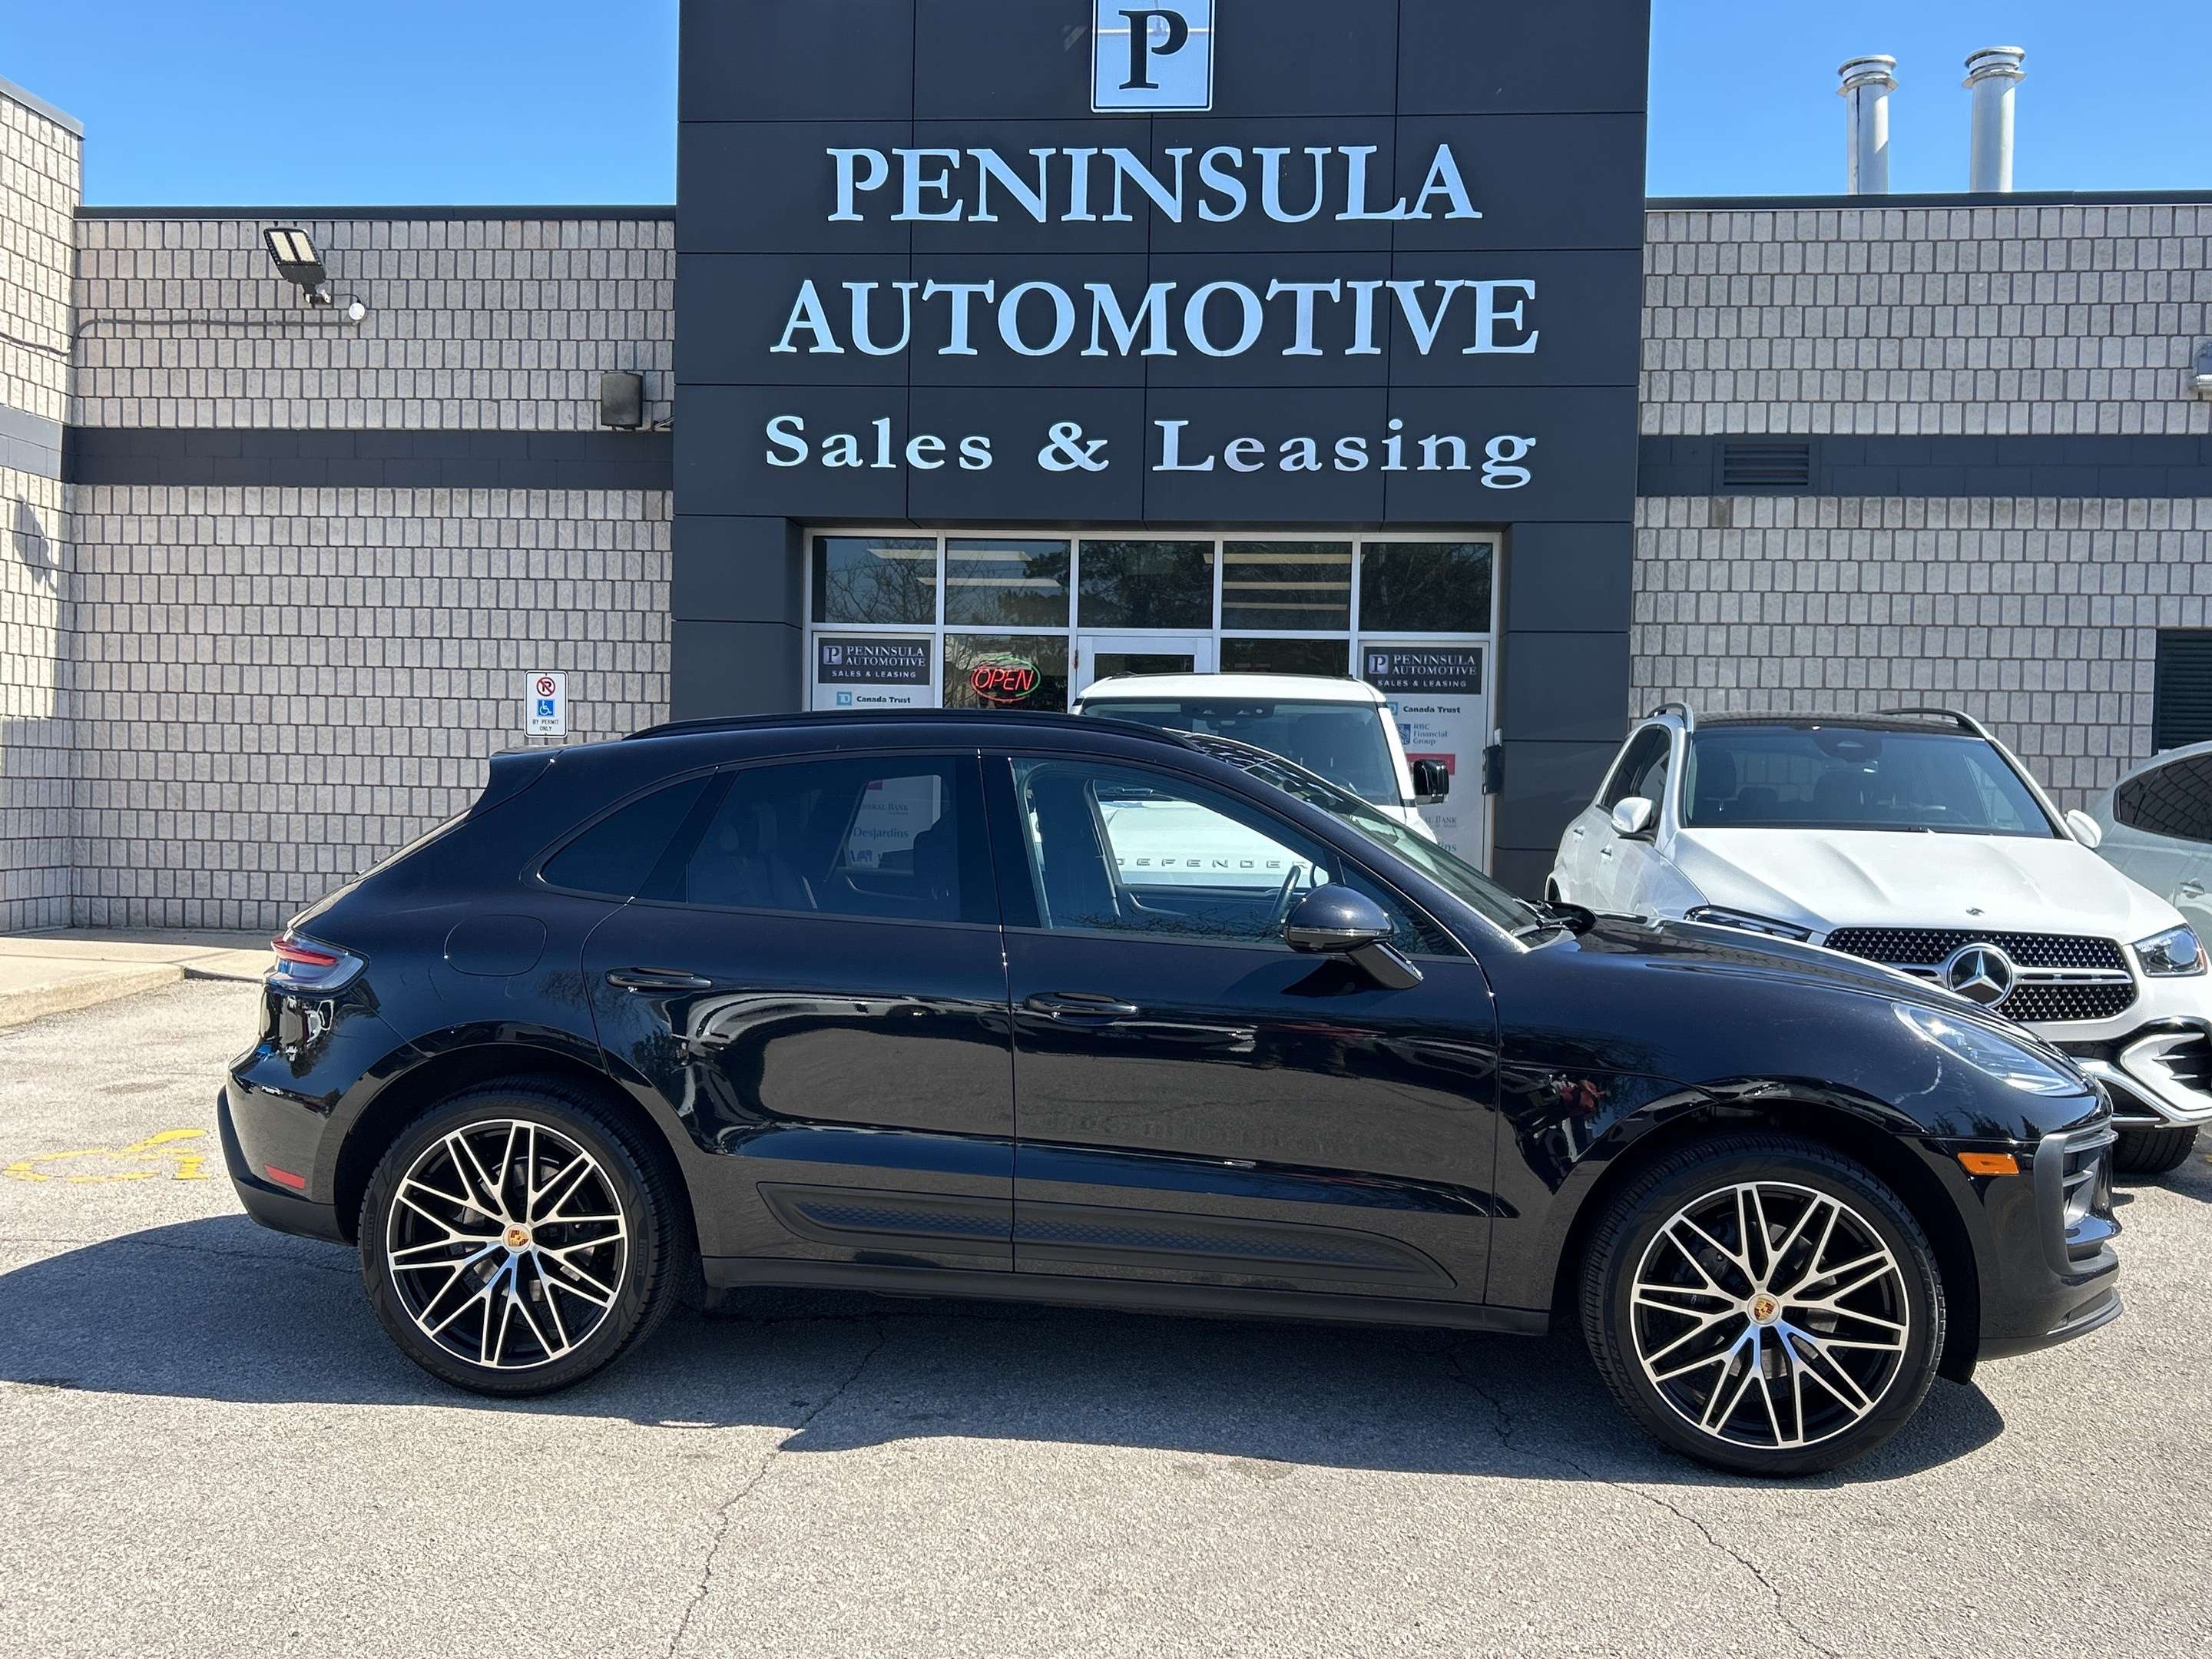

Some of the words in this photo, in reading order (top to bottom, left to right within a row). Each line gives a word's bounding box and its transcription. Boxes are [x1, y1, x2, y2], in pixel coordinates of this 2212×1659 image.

[1118, 9, 1188, 90] P
[826, 144, 1483, 224] PENINSULA
[769, 278, 1539, 358] AUTOMOTIVE
[766, 416, 993, 472] Sales
[1037, 421, 1109, 473] &
[1152, 418, 1537, 490] Leasing
[826, 647, 839, 664] P
[846, 646, 925, 657] PENINSULA
[1393, 654, 1475, 665] PENINSULA
[846, 657, 926, 667] AUTOMOTIVE
[1372, 655, 1386, 673] P
[1392, 665, 1477, 675] AUTOMOTIVE
[975, 668, 1035, 690] OPEN
[1412, 737, 1436, 746] Group
[854, 827, 909, 839] Desjardins
